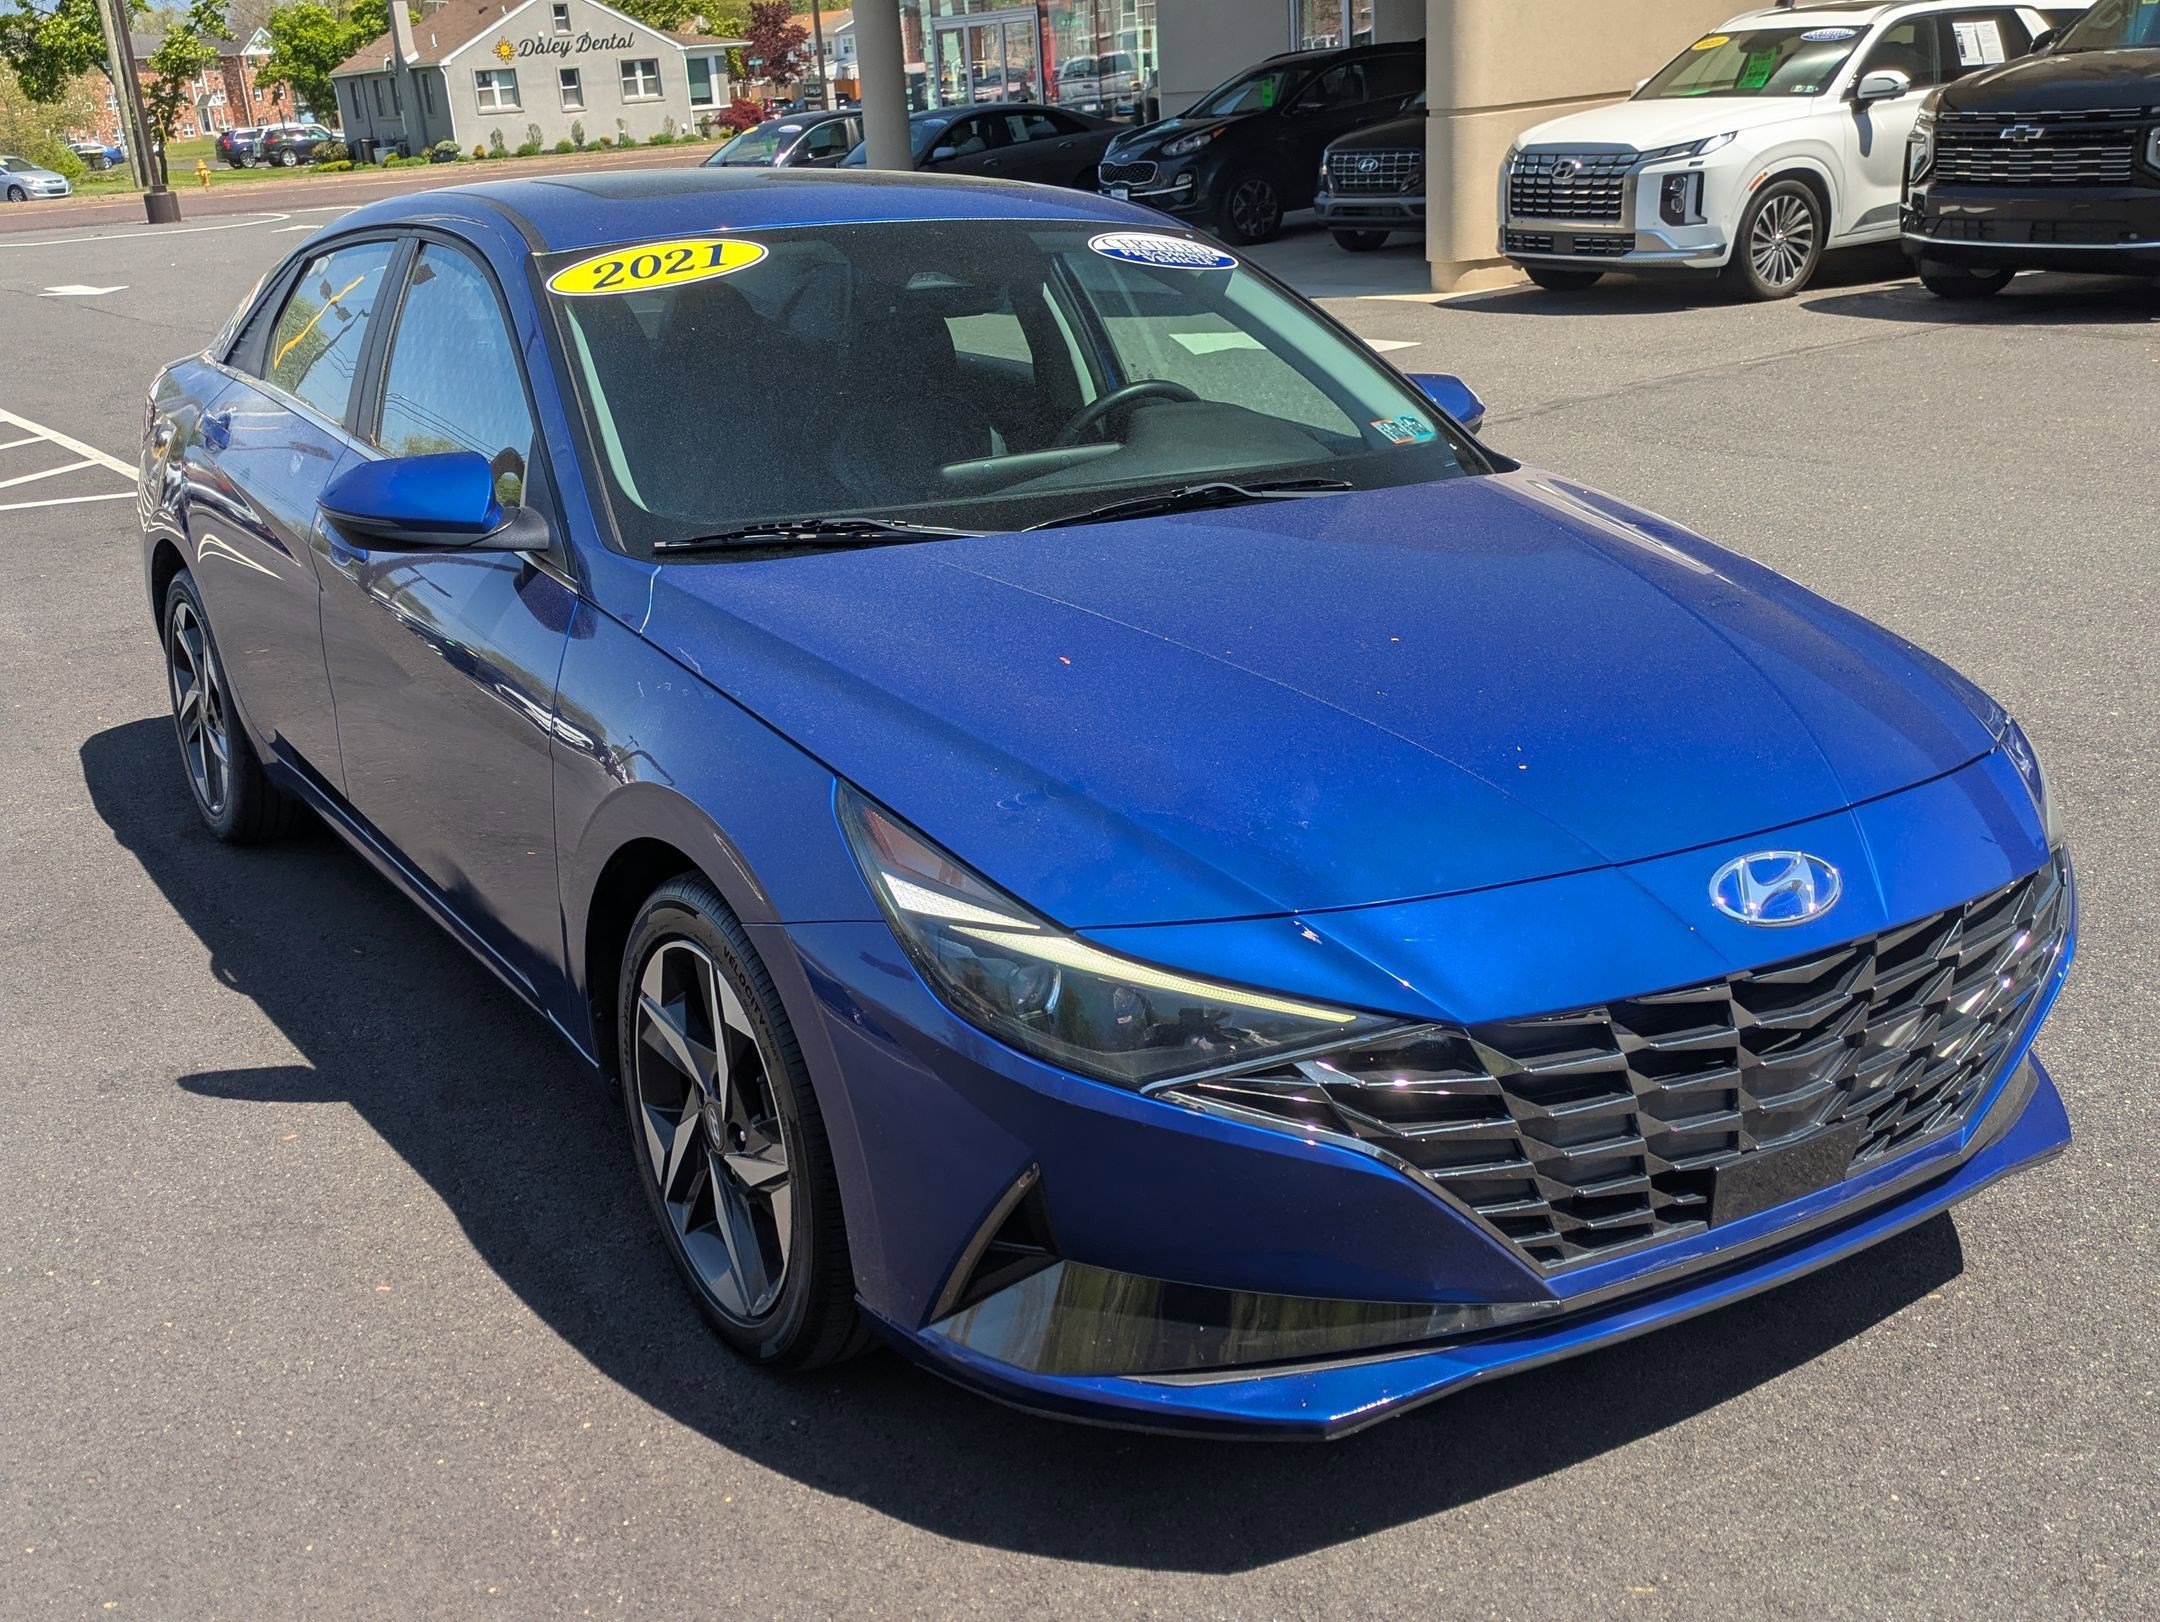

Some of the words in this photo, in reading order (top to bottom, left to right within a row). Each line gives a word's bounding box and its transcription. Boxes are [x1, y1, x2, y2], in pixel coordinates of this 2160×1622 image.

[518, 37, 573, 58] Daley
[576, 31, 635, 53] Dental
[593, 243, 728, 290] 2021
[1143, 254, 1218, 266] VEHICLE
[723, 945, 766, 1025] VELOCITY
